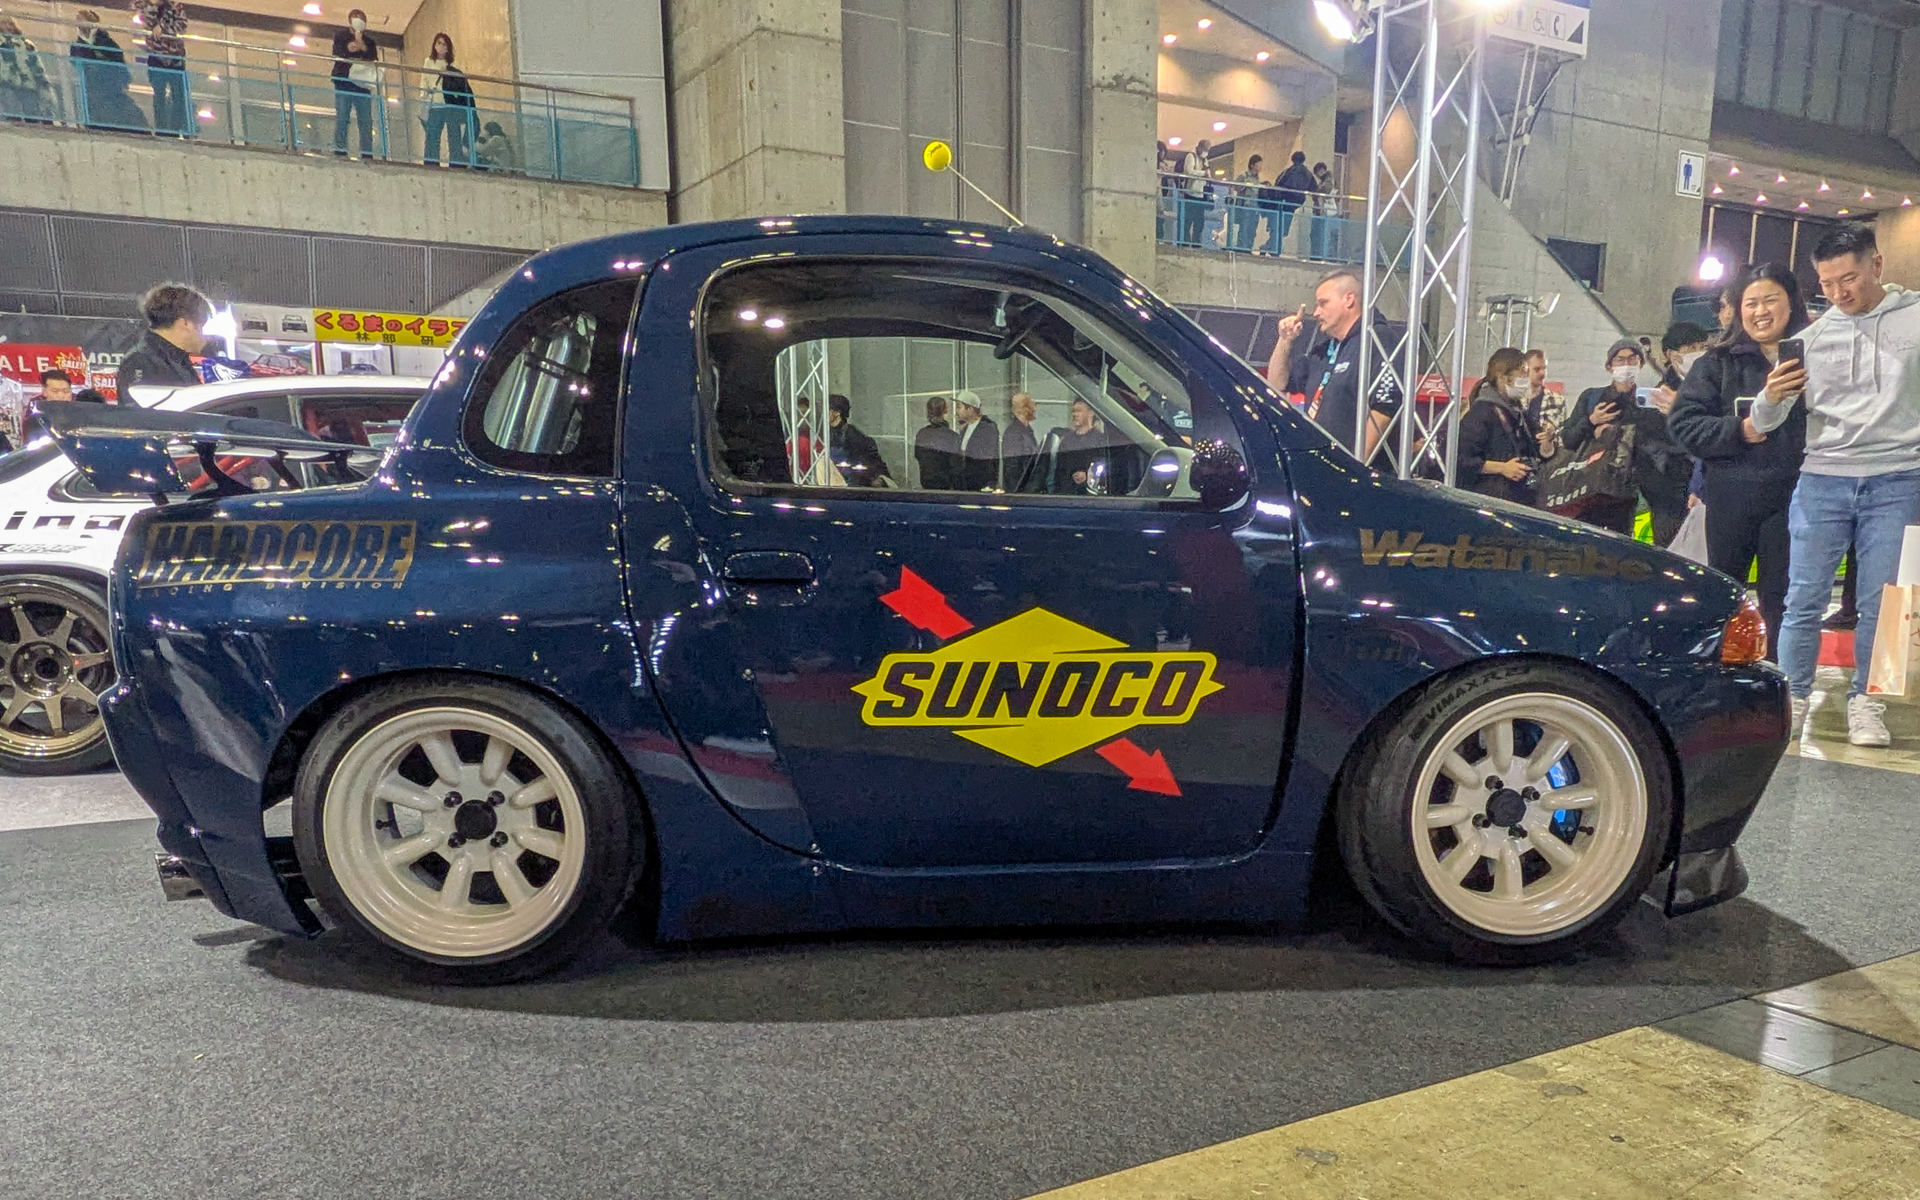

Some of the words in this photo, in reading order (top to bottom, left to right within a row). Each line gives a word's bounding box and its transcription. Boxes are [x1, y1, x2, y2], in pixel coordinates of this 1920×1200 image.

[141, 523, 410, 584] HARDCORE
[1359, 528, 1653, 582] Watanabe
[265, 581, 404, 590] DIVISION
[872, 660, 1206, 718] SUNOCO
